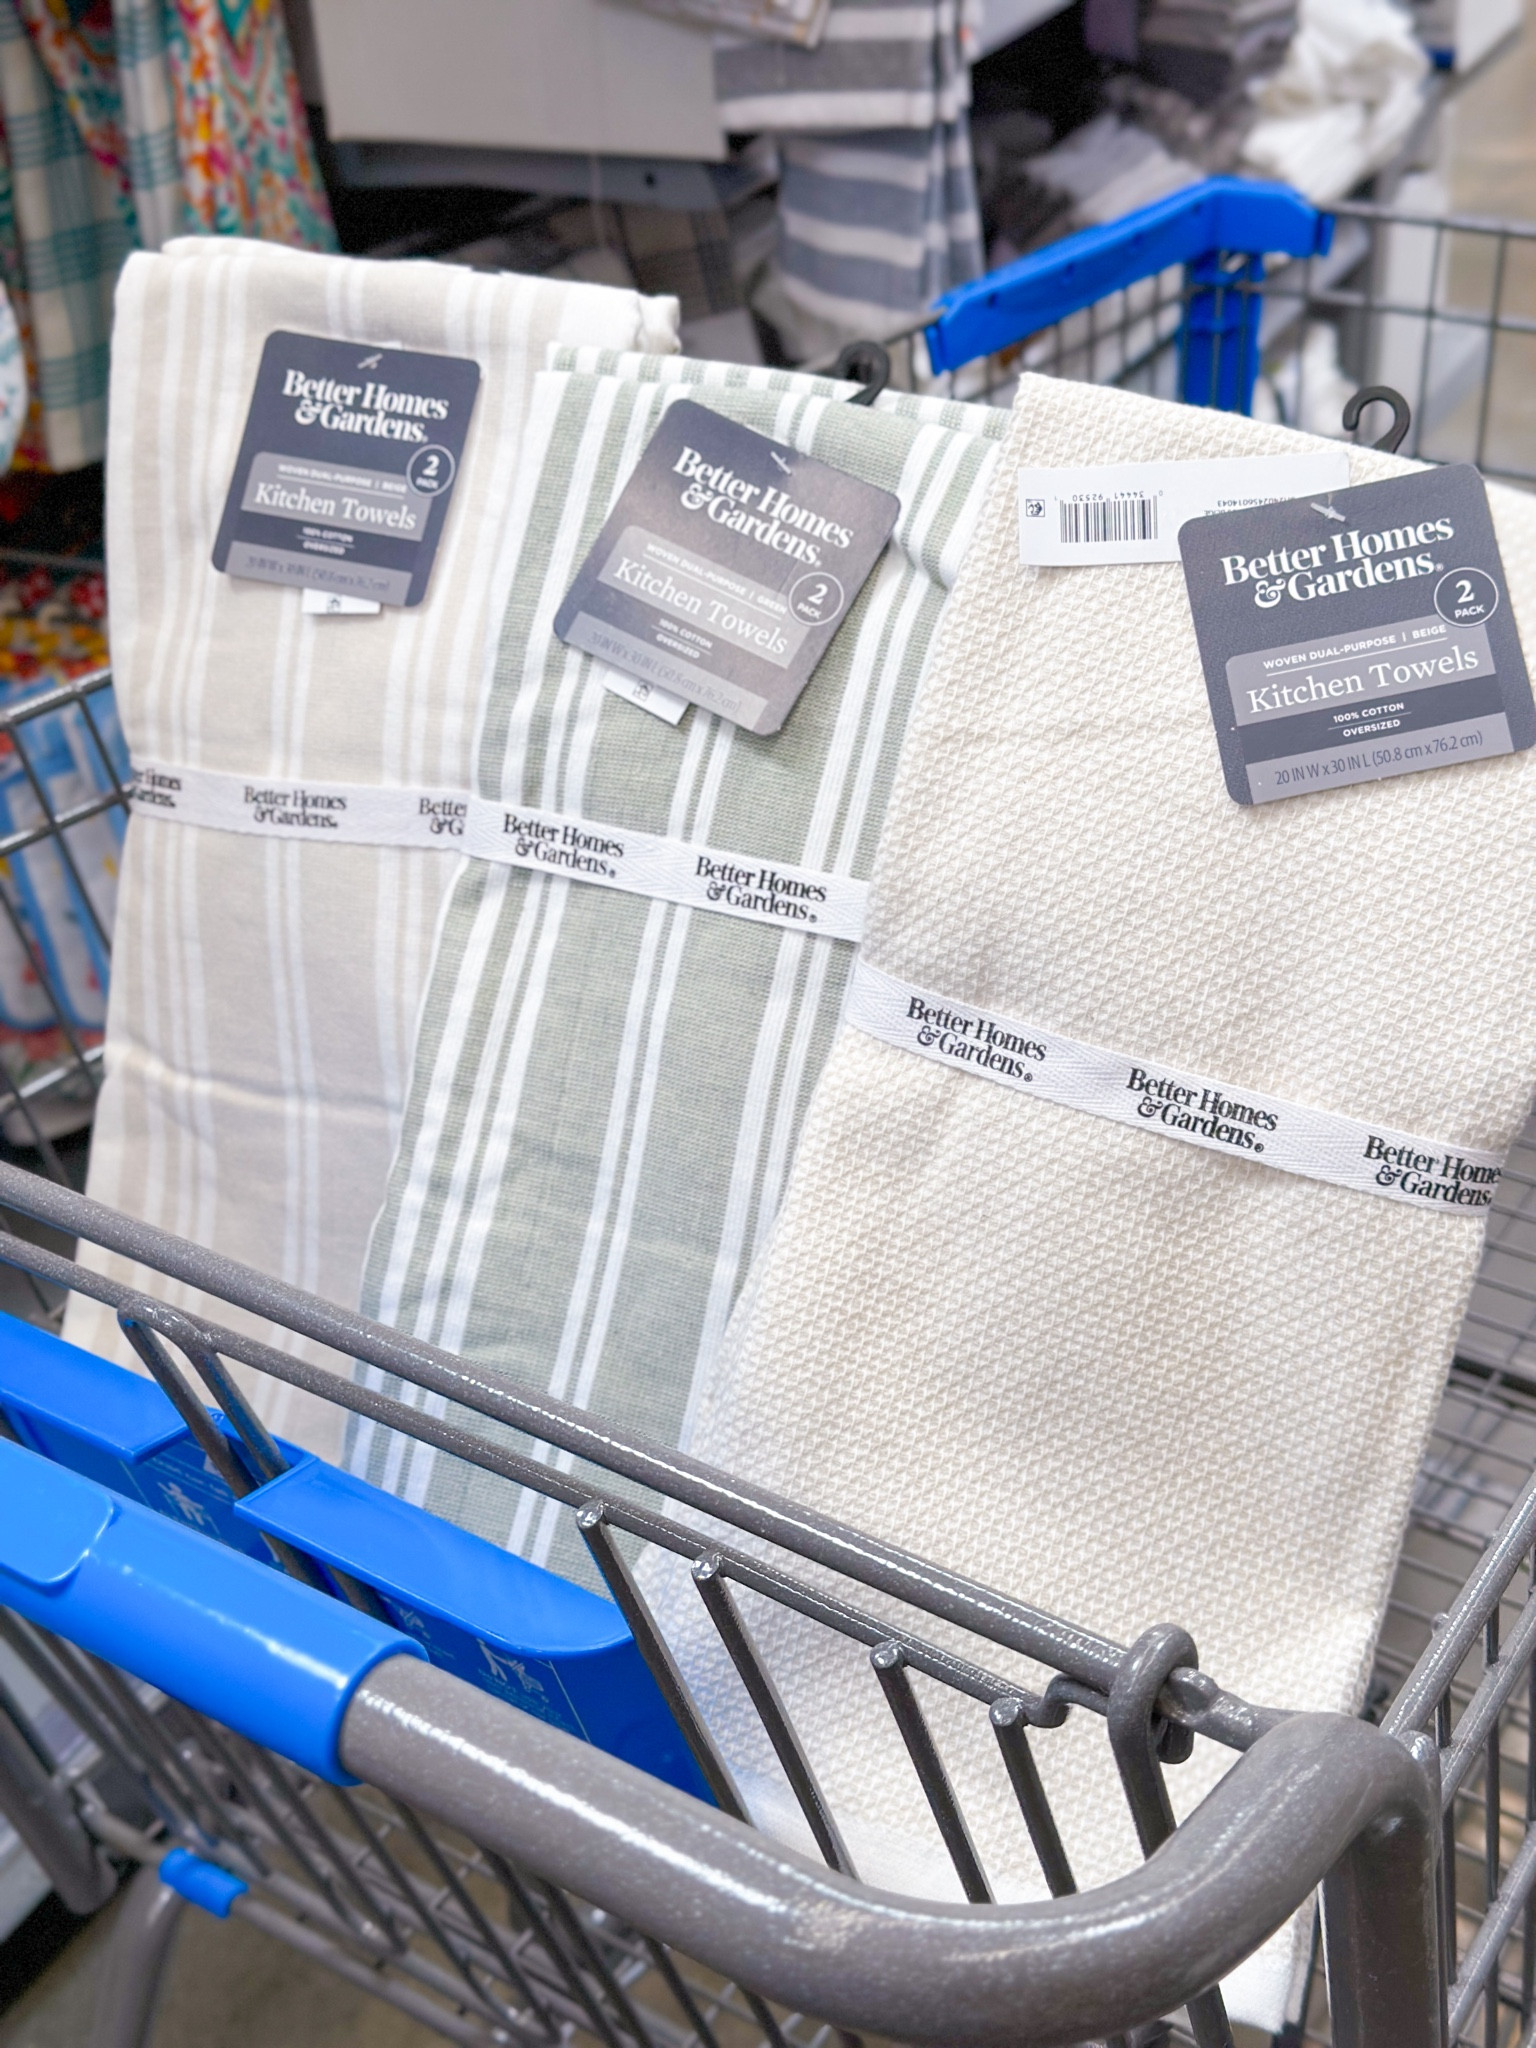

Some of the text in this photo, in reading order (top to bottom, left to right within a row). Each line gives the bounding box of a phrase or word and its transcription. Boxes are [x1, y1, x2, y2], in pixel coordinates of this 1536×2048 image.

[282, 369, 449, 420] Better Homes
[422, 455, 440, 476] 2
[254, 482, 416, 530] Kitchen Towels
[672, 447, 854, 549] Better Homes
[1072, 493, 1103, 502] 92530
[1114, 490, 1144, 499] 34441
[1220, 517, 1454, 586] Better Homes
[646, 543, 788, 615] WOVEN DUAL-PURPOSE GREEN
[807, 583, 828, 605] 2
[1454, 579, 1475, 604] 2
[613, 557, 788, 655] Kitchen Towels
[797, 602, 822, 619] PACK
[1454, 604, 1485, 618] PACK
[656, 633, 701, 660] OVERSIZED
[679, 628, 713, 649] COTTON
[1263, 624, 1447, 669] WOVEN DUAL-PURPOSE BEIGE
[1246, 645, 1479, 714] Kitchen Towels
[1333, 702, 1404, 723] 100% COTTON
[1342, 719, 1401, 738] OVERSIZED
[1275, 730, 1483, 785] 20 IN W x 30 IN L (50.8 cm x 76.2 cm)
[243, 785, 347, 811] Better Homes
[503, 813, 624, 859] Better Homes
[695, 855, 828, 903] Better Homes
[906, 996, 1047, 1061] Better Homes
[1126, 1067, 1278, 1132] Better Homes
[1363, 1135, 1439, 1173] Better
